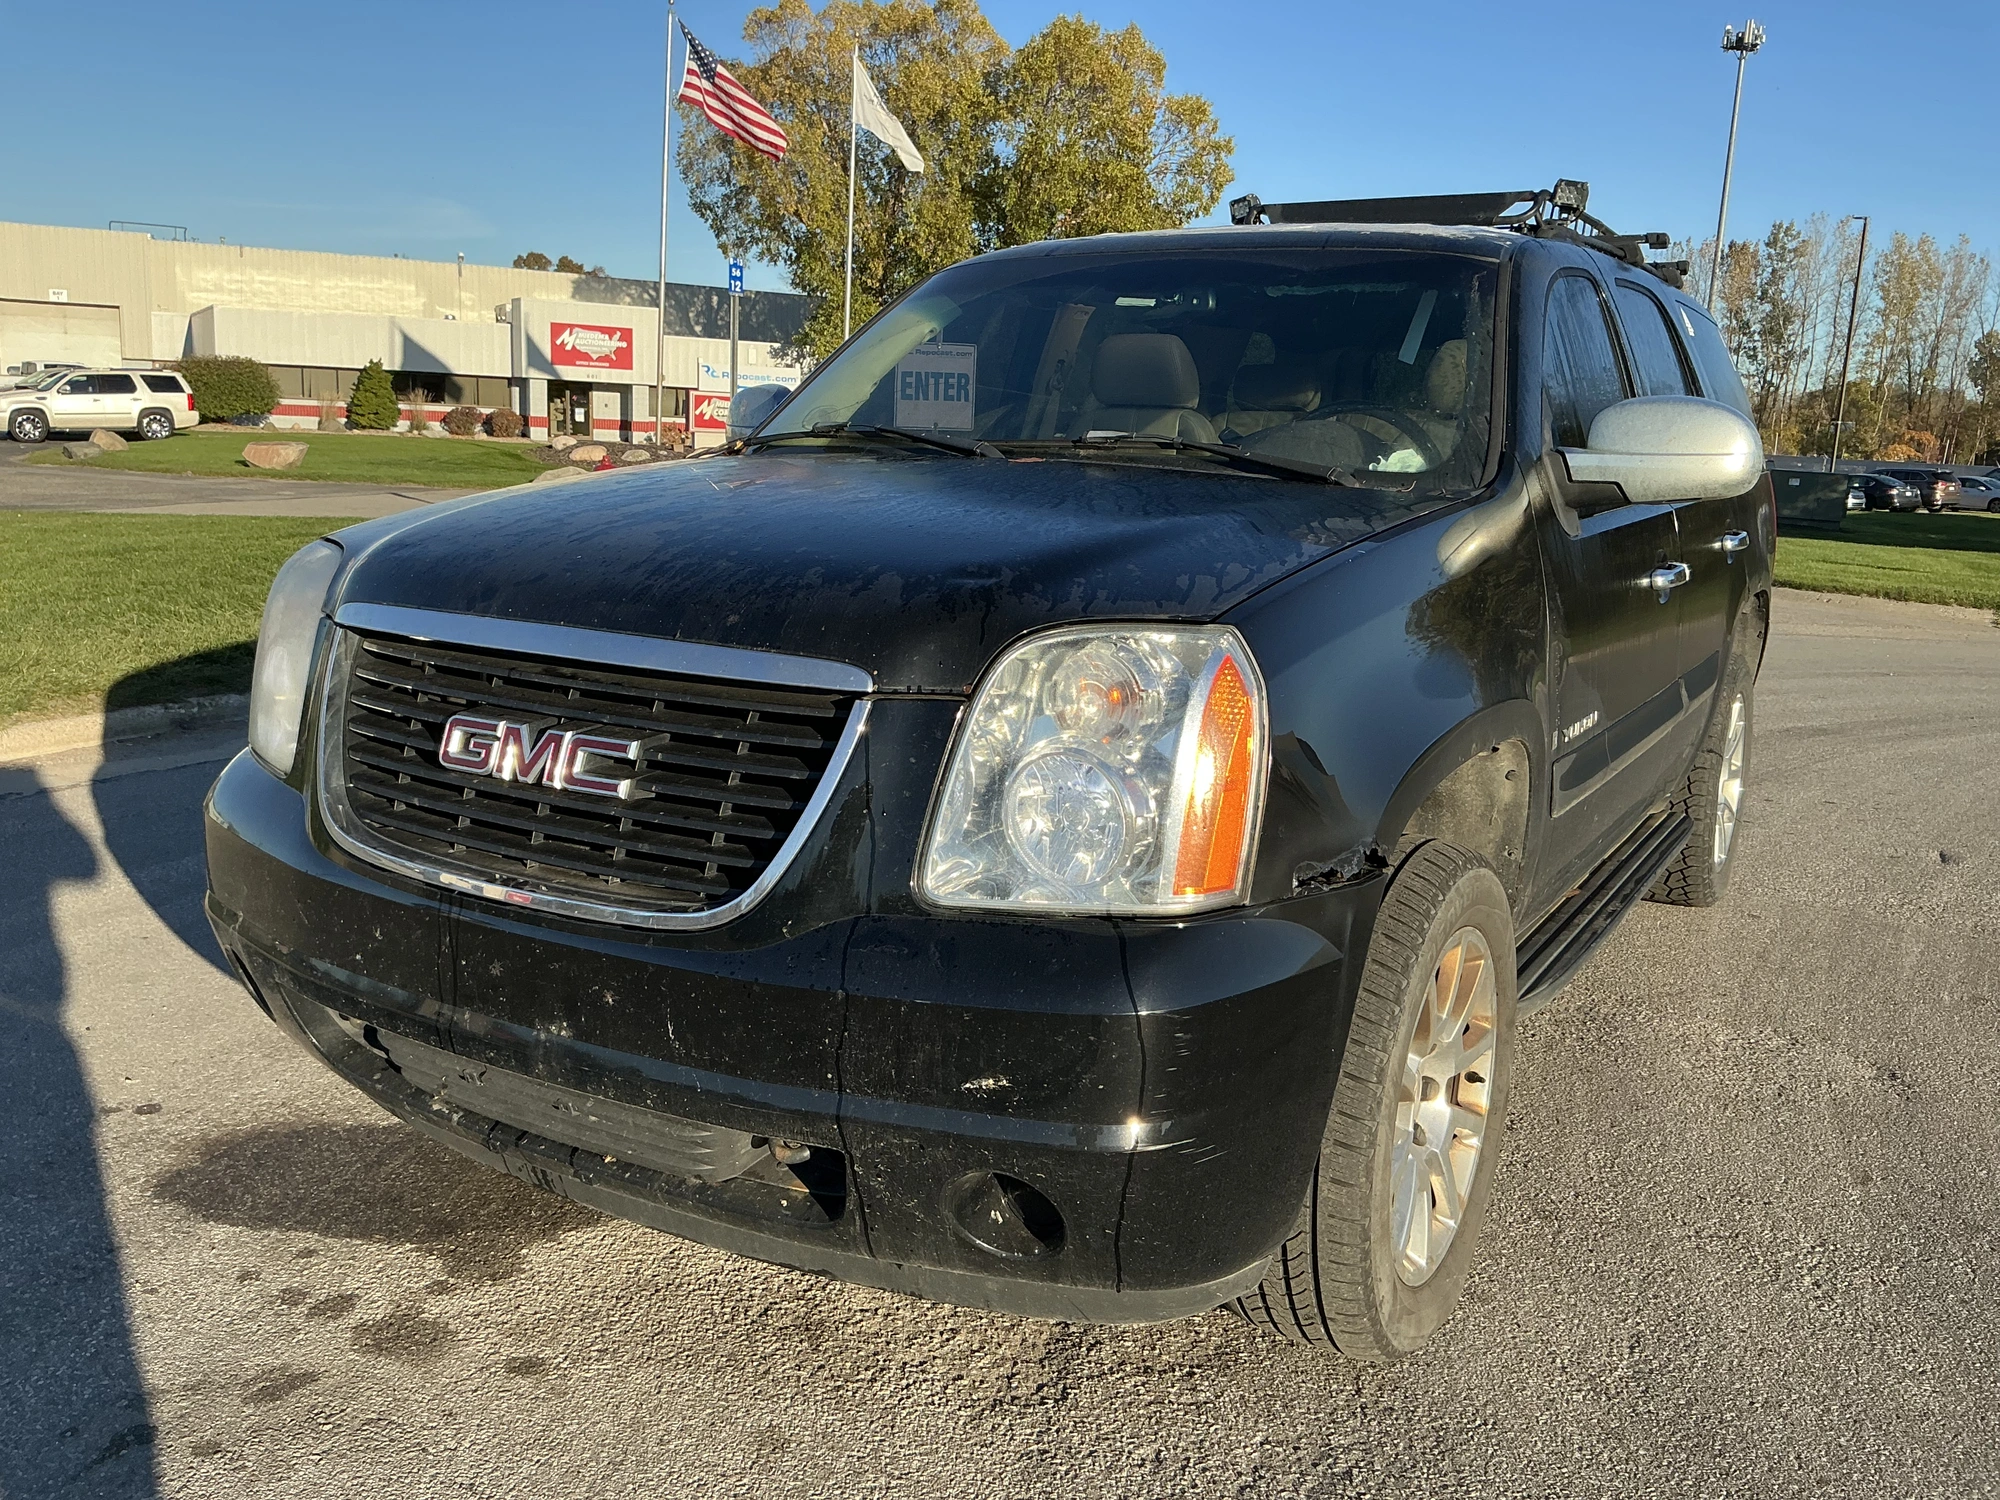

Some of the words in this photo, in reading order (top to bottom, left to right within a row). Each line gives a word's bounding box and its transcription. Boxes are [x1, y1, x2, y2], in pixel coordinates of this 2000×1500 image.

[730, 280, 742, 292] 12
[575, 339, 627, 348] AUCTIONEERING
[915, 349, 974, 357] Repocast.com
[900, 371, 970, 402] ENTER
[439, 714, 641, 800] GMC
